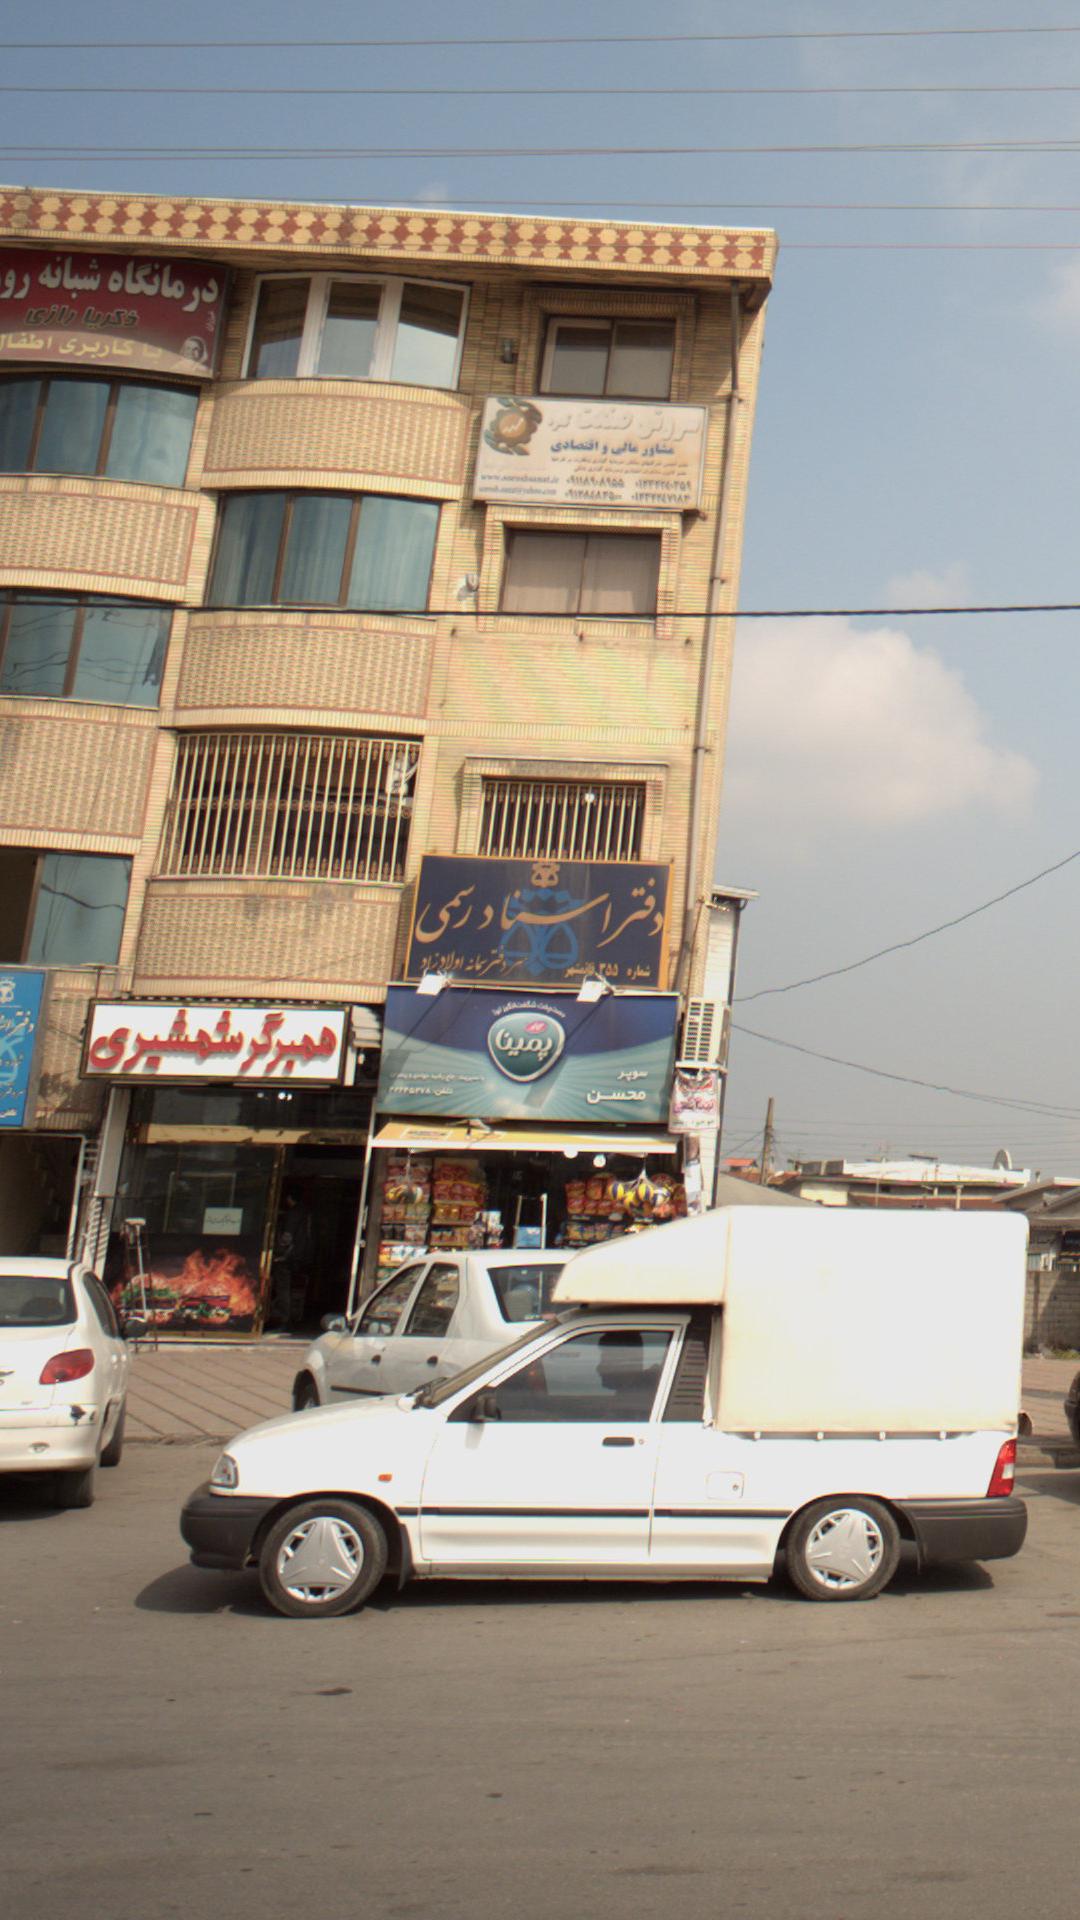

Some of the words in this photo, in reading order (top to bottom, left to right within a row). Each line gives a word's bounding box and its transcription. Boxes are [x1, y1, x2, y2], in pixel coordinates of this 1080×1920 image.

[0, 268, 31, 299] رو
[37, 256, 102, 299] شبانه
[107, 261, 219, 312] درمانگاه
[23, 304, 78, 327] رازی
[58, 336, 135, 359] کاربری
[550, 440, 598, 453] اقتصادی
[602, 445, 608, 455] و
[641, 443, 675, 457] مشاور
[414, 884, 476, 943] رسمی
[477, 889, 613, 931] اسناد
[597, 878, 664, 948] دفتر
[599, 962, 618, 977] ۳۵۵
[627, 963, 651, 980] شماره
[89, 1008, 245, 1072] شمشیری
[238, 1011, 338, 1075] همبرگر
[495, 1028, 553, 1062] پمینا
[617, 1070, 648, 1082] سوپر
[586, 1089, 647, 1104] محسن
